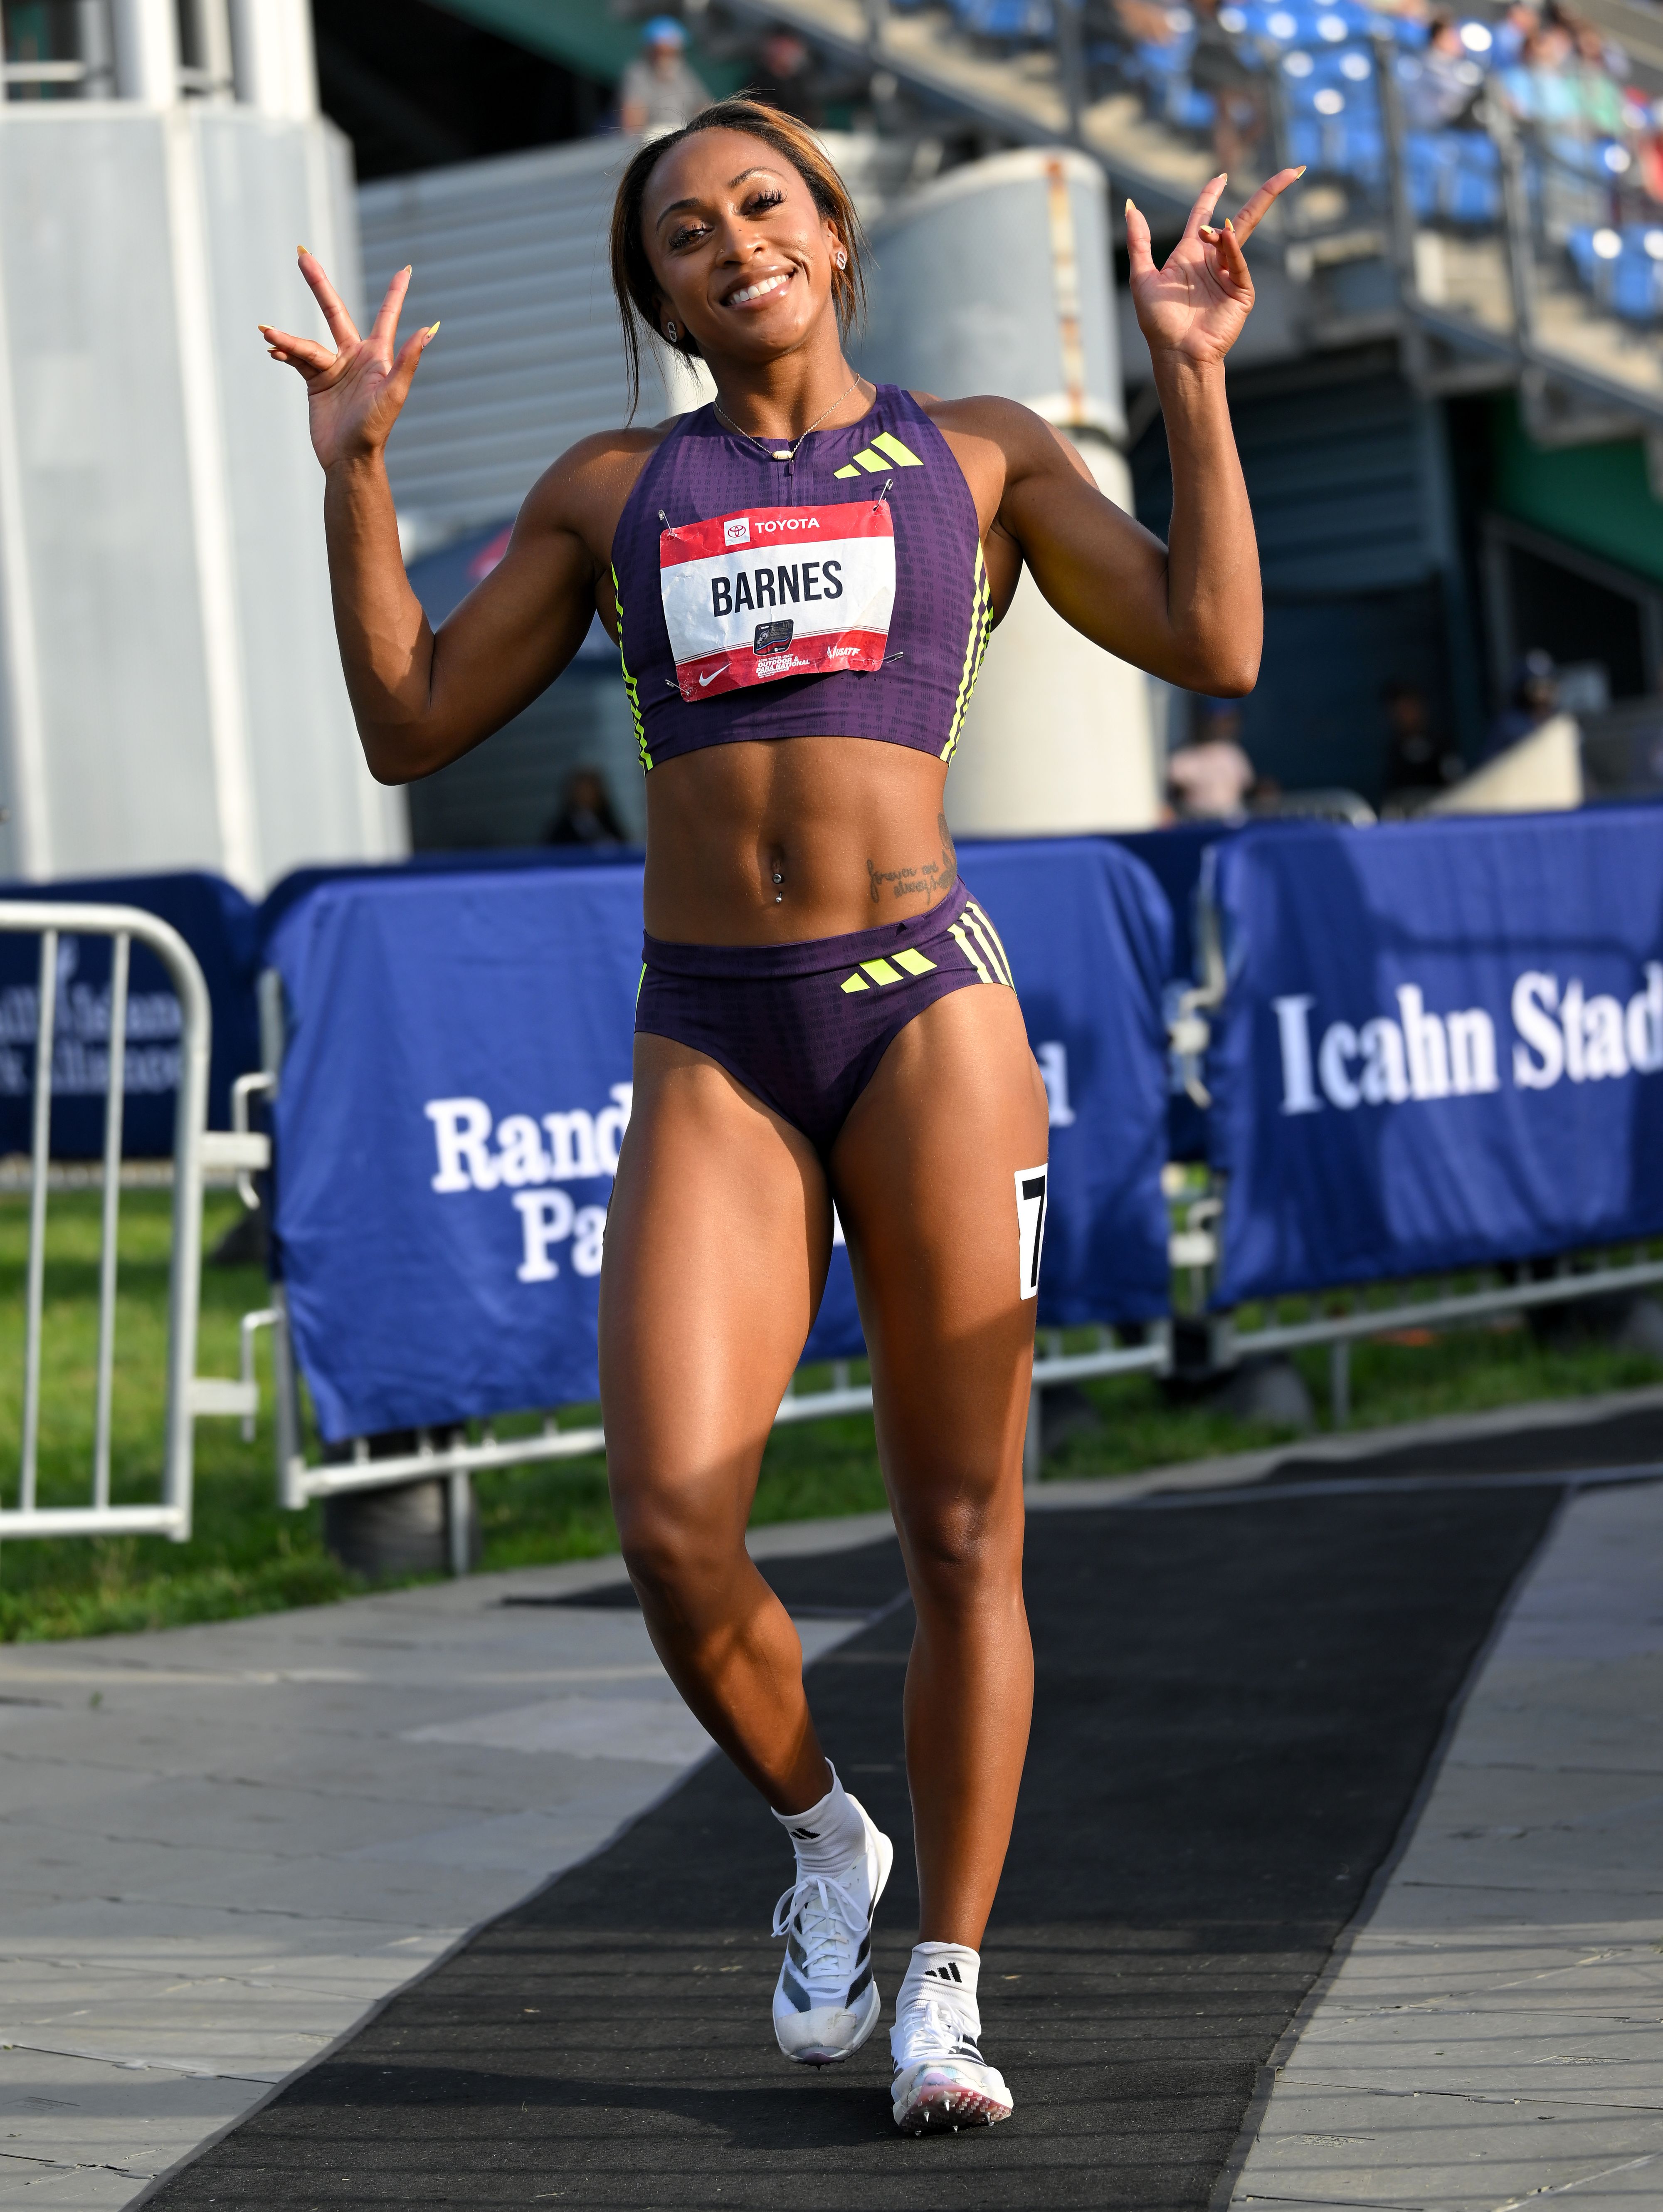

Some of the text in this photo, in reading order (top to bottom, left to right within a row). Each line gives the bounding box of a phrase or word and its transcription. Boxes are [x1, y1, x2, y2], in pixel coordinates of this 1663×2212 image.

[755, 518, 820, 533] TOYOTA
[711, 560, 843, 617] BARNES
[756, 659, 810, 673] PARA NATIONAL
[758, 657, 792, 668] OUTDOOR
[836, 647, 861, 657] USATF
[1272, 960, 1663, 1116] Icahn Stad
[512, 1187, 607, 1283] Pa
[1022, 1175, 1045, 1288] 7
